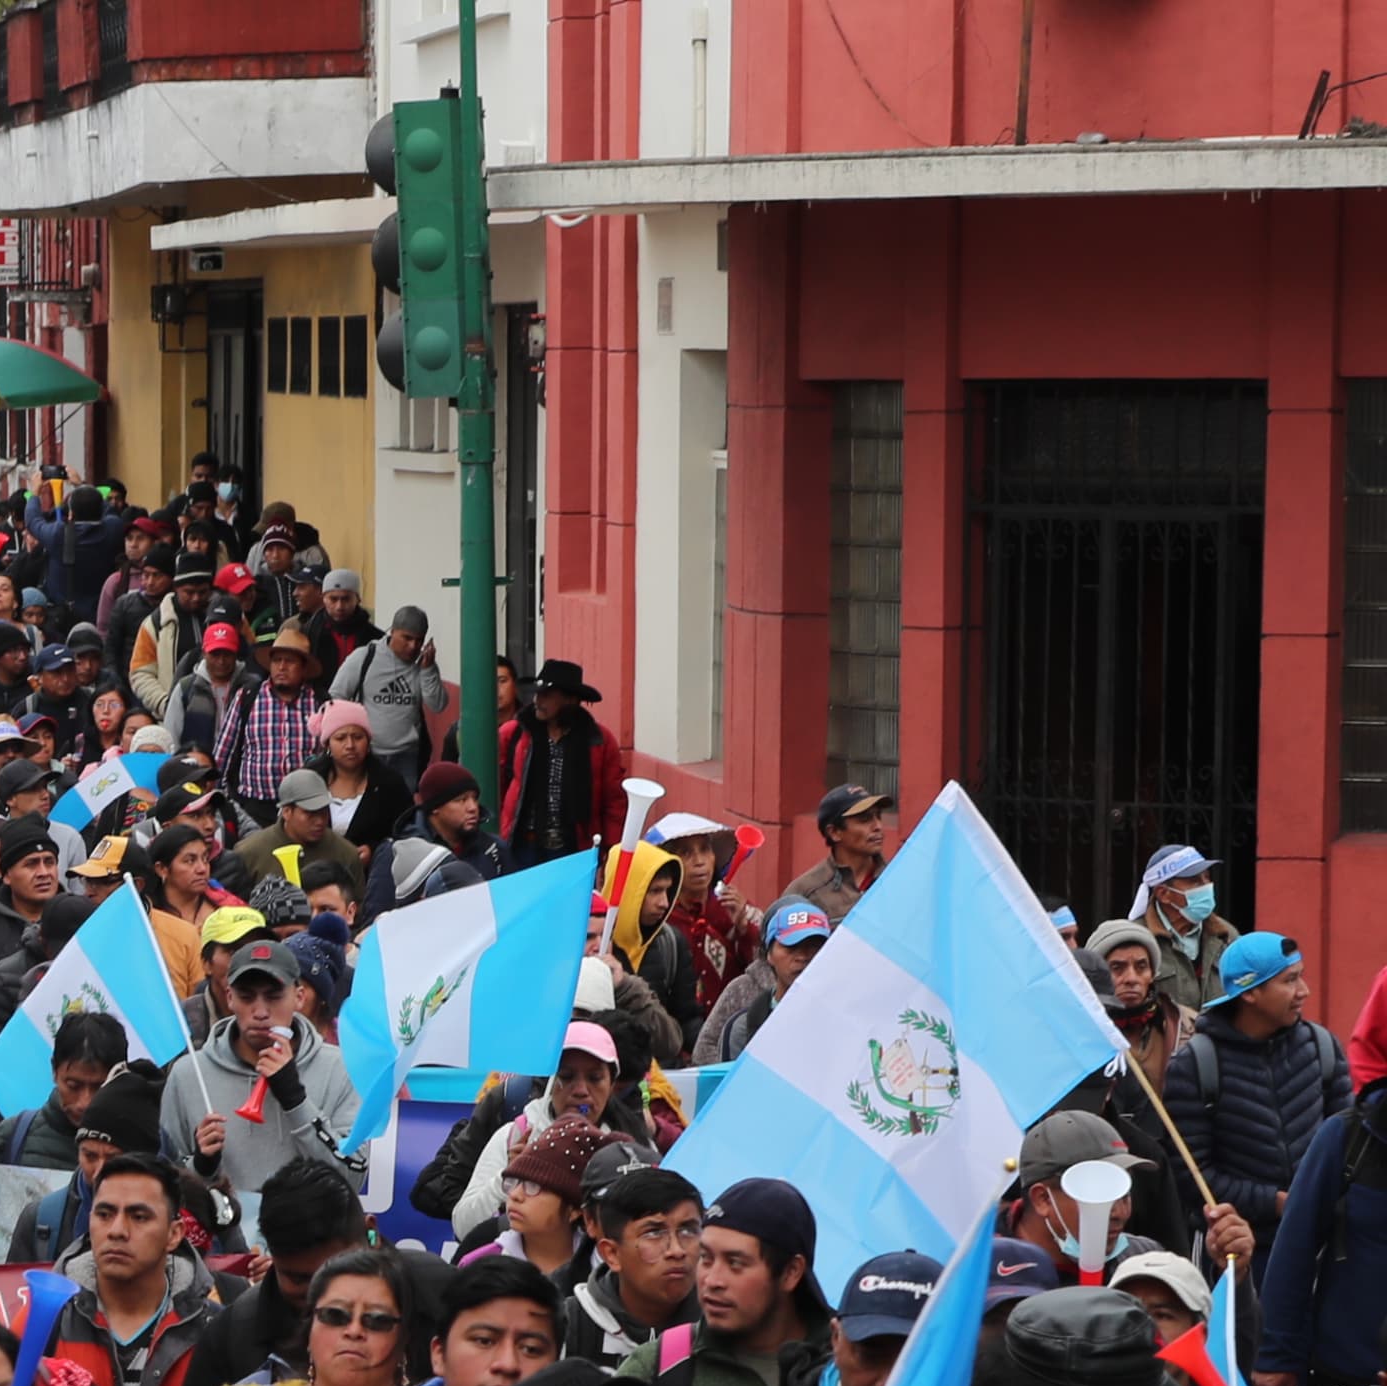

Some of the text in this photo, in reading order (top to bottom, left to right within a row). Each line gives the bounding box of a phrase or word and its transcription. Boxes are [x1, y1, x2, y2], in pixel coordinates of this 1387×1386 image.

[373, 693, 416, 705] adidas
[788, 911, 808, 926] 93
[859, 1274, 936, 1300] Champi
